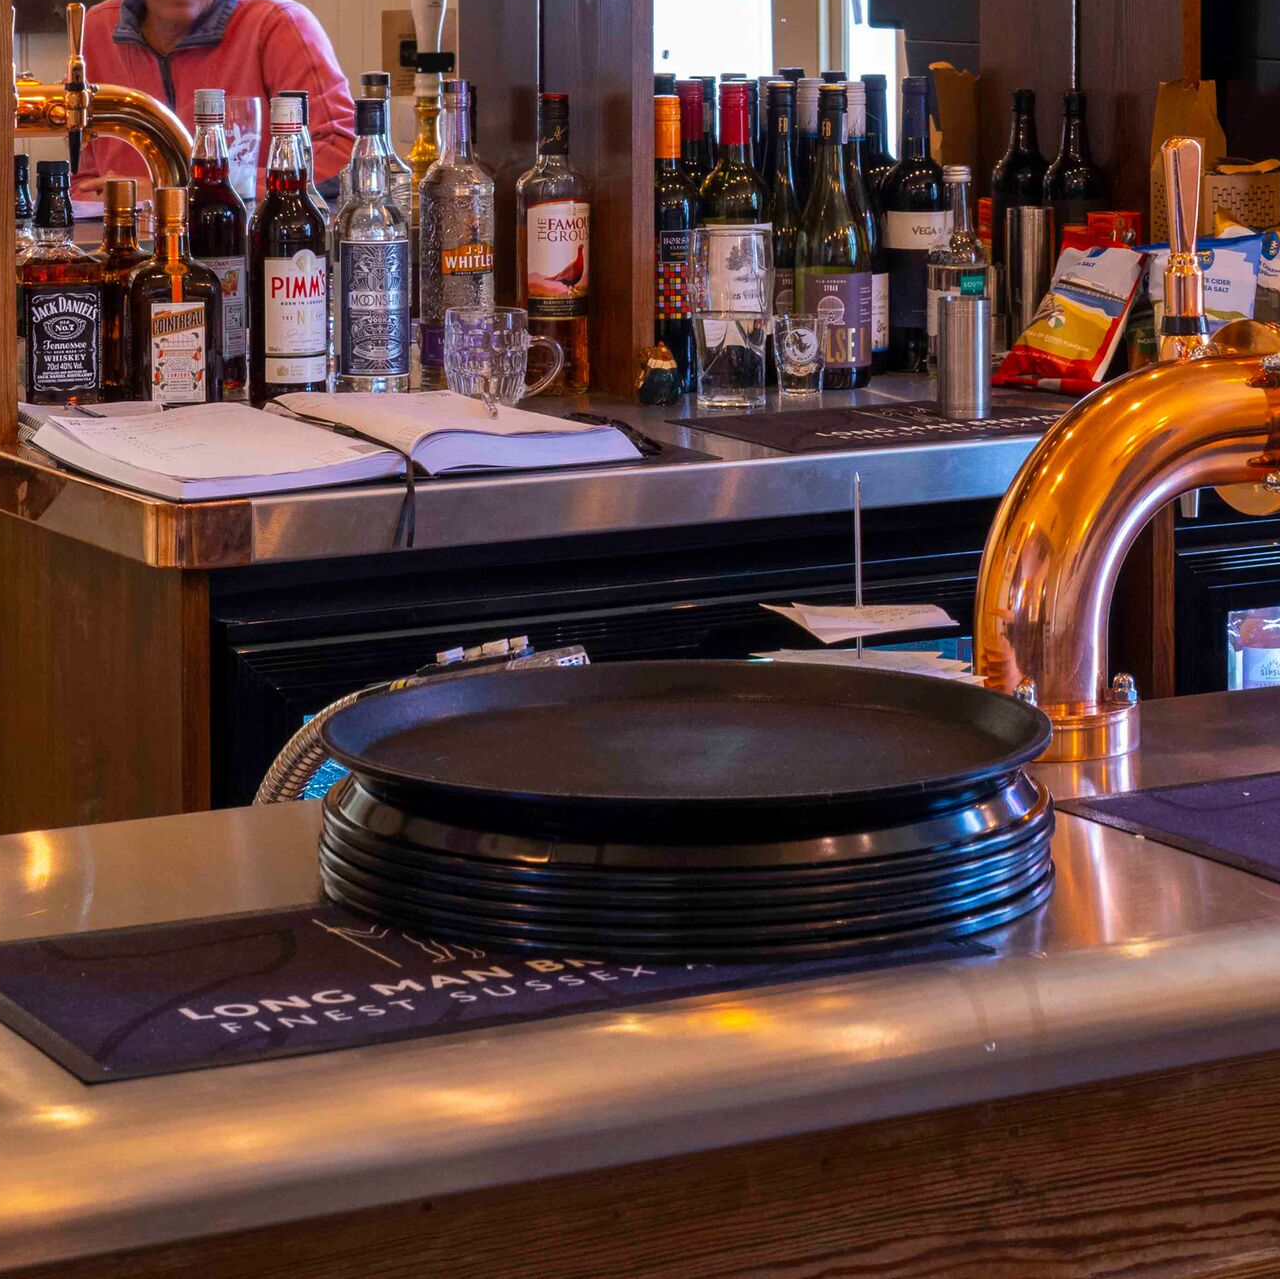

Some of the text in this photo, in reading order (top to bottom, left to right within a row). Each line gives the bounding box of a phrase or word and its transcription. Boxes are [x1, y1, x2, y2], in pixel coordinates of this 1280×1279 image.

[538, 218, 548, 242] THE
[912, 227, 937, 236] VEGA
[271, 269, 326, 300] PIMM'S
[1211, 278, 1231, 287] CIDER
[31, 296, 98, 323] JACK DANIEL'S
[55, 323, 75, 332] No.7
[152, 309, 204, 335] COINTREAU
[42, 339, 88, 350] Tennessee
[44, 353, 87, 362] WHISKEY
[47, 361, 84, 371] 70cl 40% Vol.
[178, 988, 357, 1021] LONG
[370, 964, 515, 998] MAN
[220, 998, 416, 1035] FINEST
[451, 963, 658, 1004] SUSSEX
